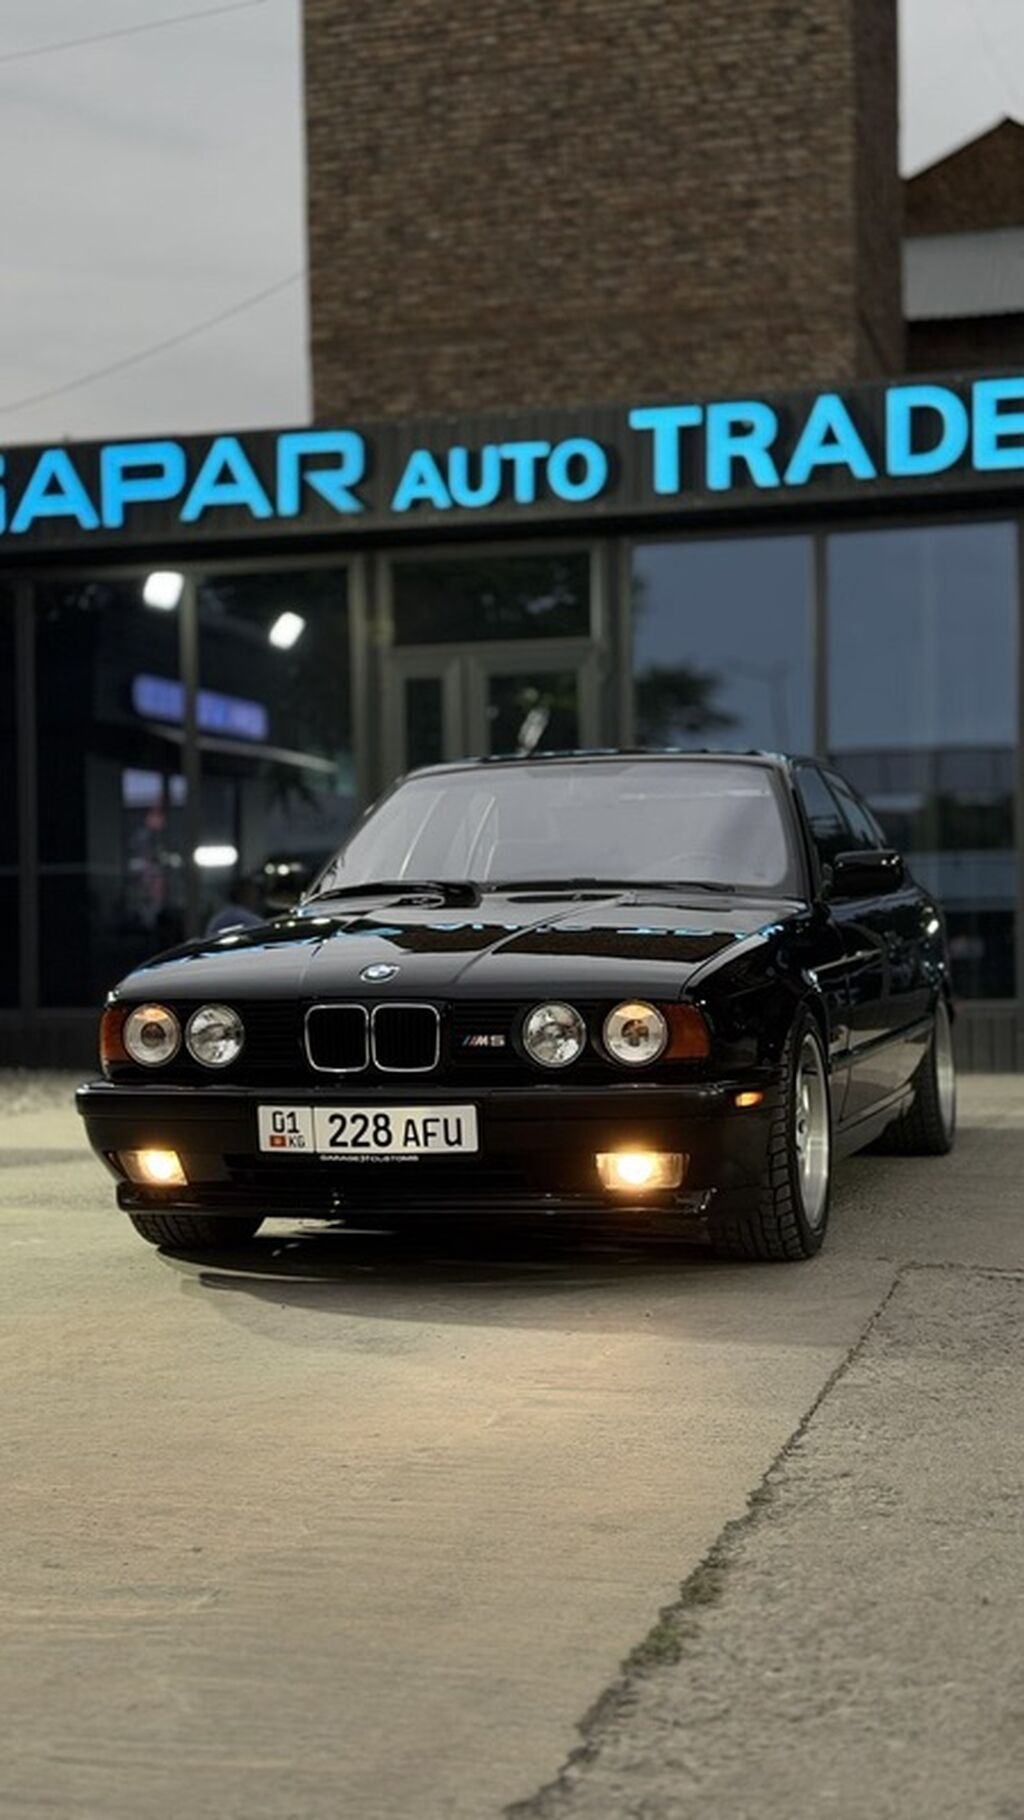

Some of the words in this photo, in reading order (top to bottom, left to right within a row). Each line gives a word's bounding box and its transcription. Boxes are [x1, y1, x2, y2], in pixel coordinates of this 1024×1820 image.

[0, 430, 364, 534] APAR
[392, 441, 608, 511] AUTO
[628, 377, 1024, 495] TRADE
[463, 1034, 506, 1048] M5
[272, 1111, 300, 1134] 01
[328, 1113, 393, 1148] 228
[402, 1117, 463, 1148] AFU
[288, 1135, 306, 1148] KG
